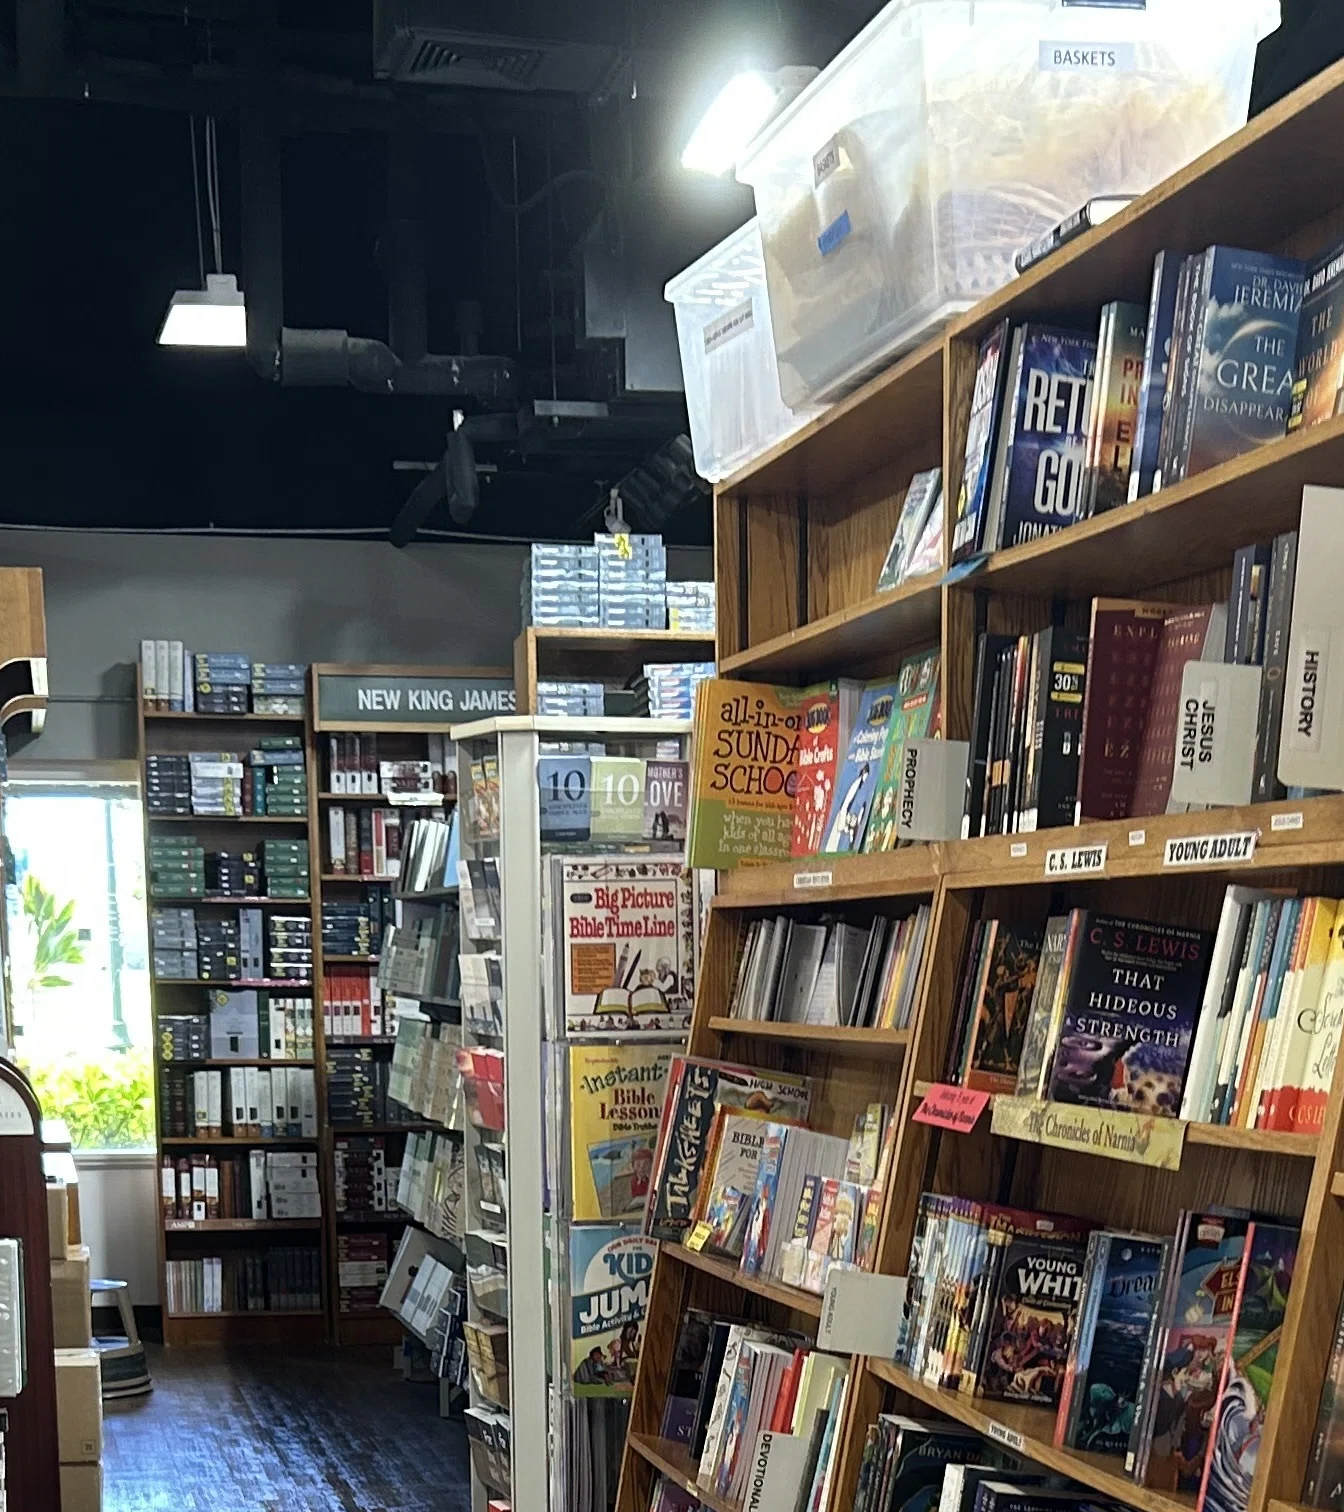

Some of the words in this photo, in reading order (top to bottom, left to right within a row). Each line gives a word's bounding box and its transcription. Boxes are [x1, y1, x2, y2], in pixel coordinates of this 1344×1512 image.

[1053, 49, 1116, 68] BASKETS
[1256, 335, 1285, 358] THE
[358, 689, 401, 711] NEW
[409, 689, 453, 711] KING
[459, 689, 516, 711] JAMES
[1297, 650, 1320, 738] HISTORY
[1179, 698, 1199, 772] CHRIST
[1199, 700, 1215, 765] JESUS
[647, 765, 683, 780] MOTHER'S
[547, 770, 585, 801] 10
[603, 773, 640, 804] 10
[899, 748, 918, 829] PROPHECY
[1048, 853, 1058, 870] C.
[1061, 852, 1069, 869] S.
[1072, 849, 1103, 868] LEWIS
[1167, 841, 1209, 862] YOUNG
[1210, 838, 1253, 859] ADULT
[594, 888, 619, 911] Big
[621, 888, 674, 909] Picture
[570, 917, 605, 939] Bible
[1112, 968, 1165, 991] THAT
[1088, 992, 1178, 1020] HIDEOUS
[1076, 1017, 1180, 1048] STRENGTH
[614, 1087, 655, 1106] Bible
[1046, 1116, 1091, 1143] Chronicles
[1092, 1123, 1104, 1144] of
[1104, 1125, 1136, 1151] Narnia
[1027, 1257, 1077, 1275] YOUNG
[581, 1322, 600, 1334] Bible
